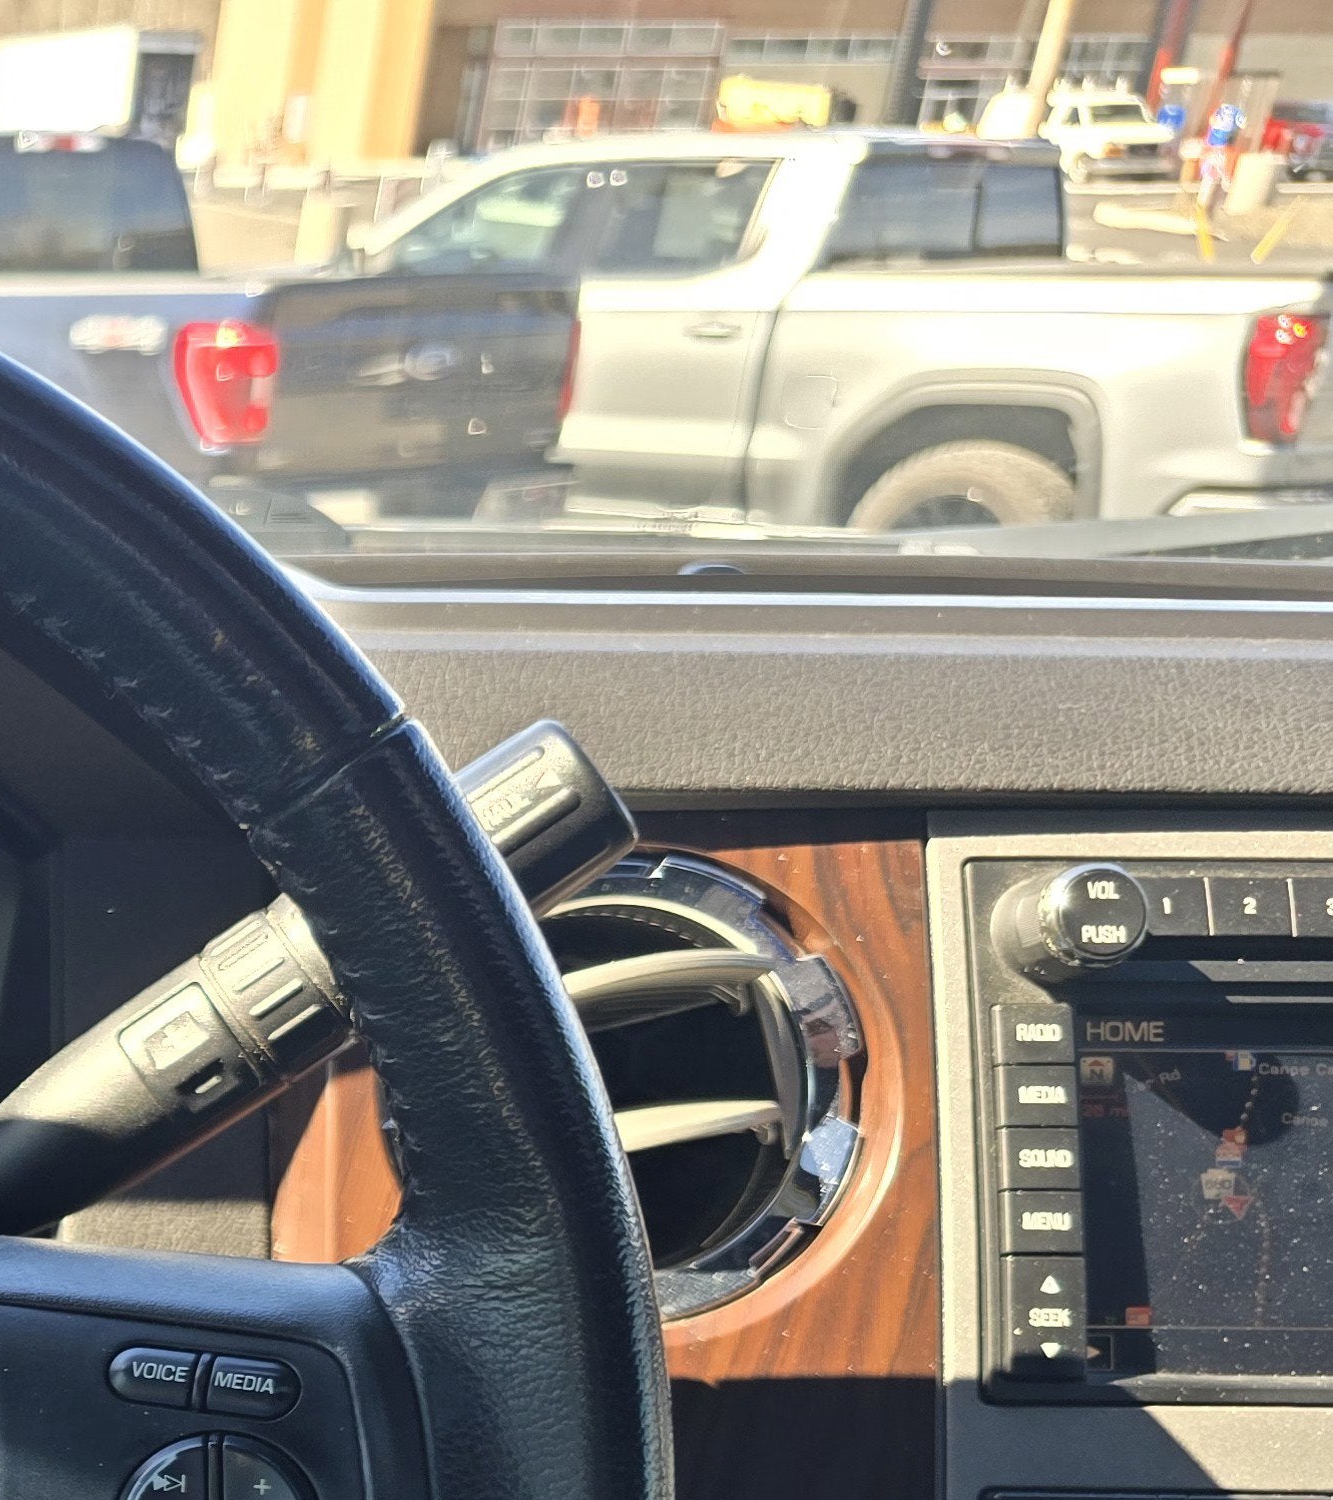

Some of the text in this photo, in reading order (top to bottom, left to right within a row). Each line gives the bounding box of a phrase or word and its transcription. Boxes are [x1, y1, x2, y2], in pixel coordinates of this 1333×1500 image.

[1087, 881, 1120, 900] VOL
[1161, 896, 1172, 915] 1
[1243, 896, 1257, 915] 2
[1081, 925, 1127, 944] PUSH
[1015, 1023, 1062, 1042] RADIO
[1086, 1021, 1165, 1042] HOME
[1018, 1085, 1068, 1104] MEDIA
[1018, 1148, 1073, 1168] SOUND
[1021, 1211, 1072, 1231] MENU
[1028, 1307, 1072, 1327] SEEK
[133, 1361, 189, 1383] VOICE
[214, 1372, 274, 1394] MEDIA
